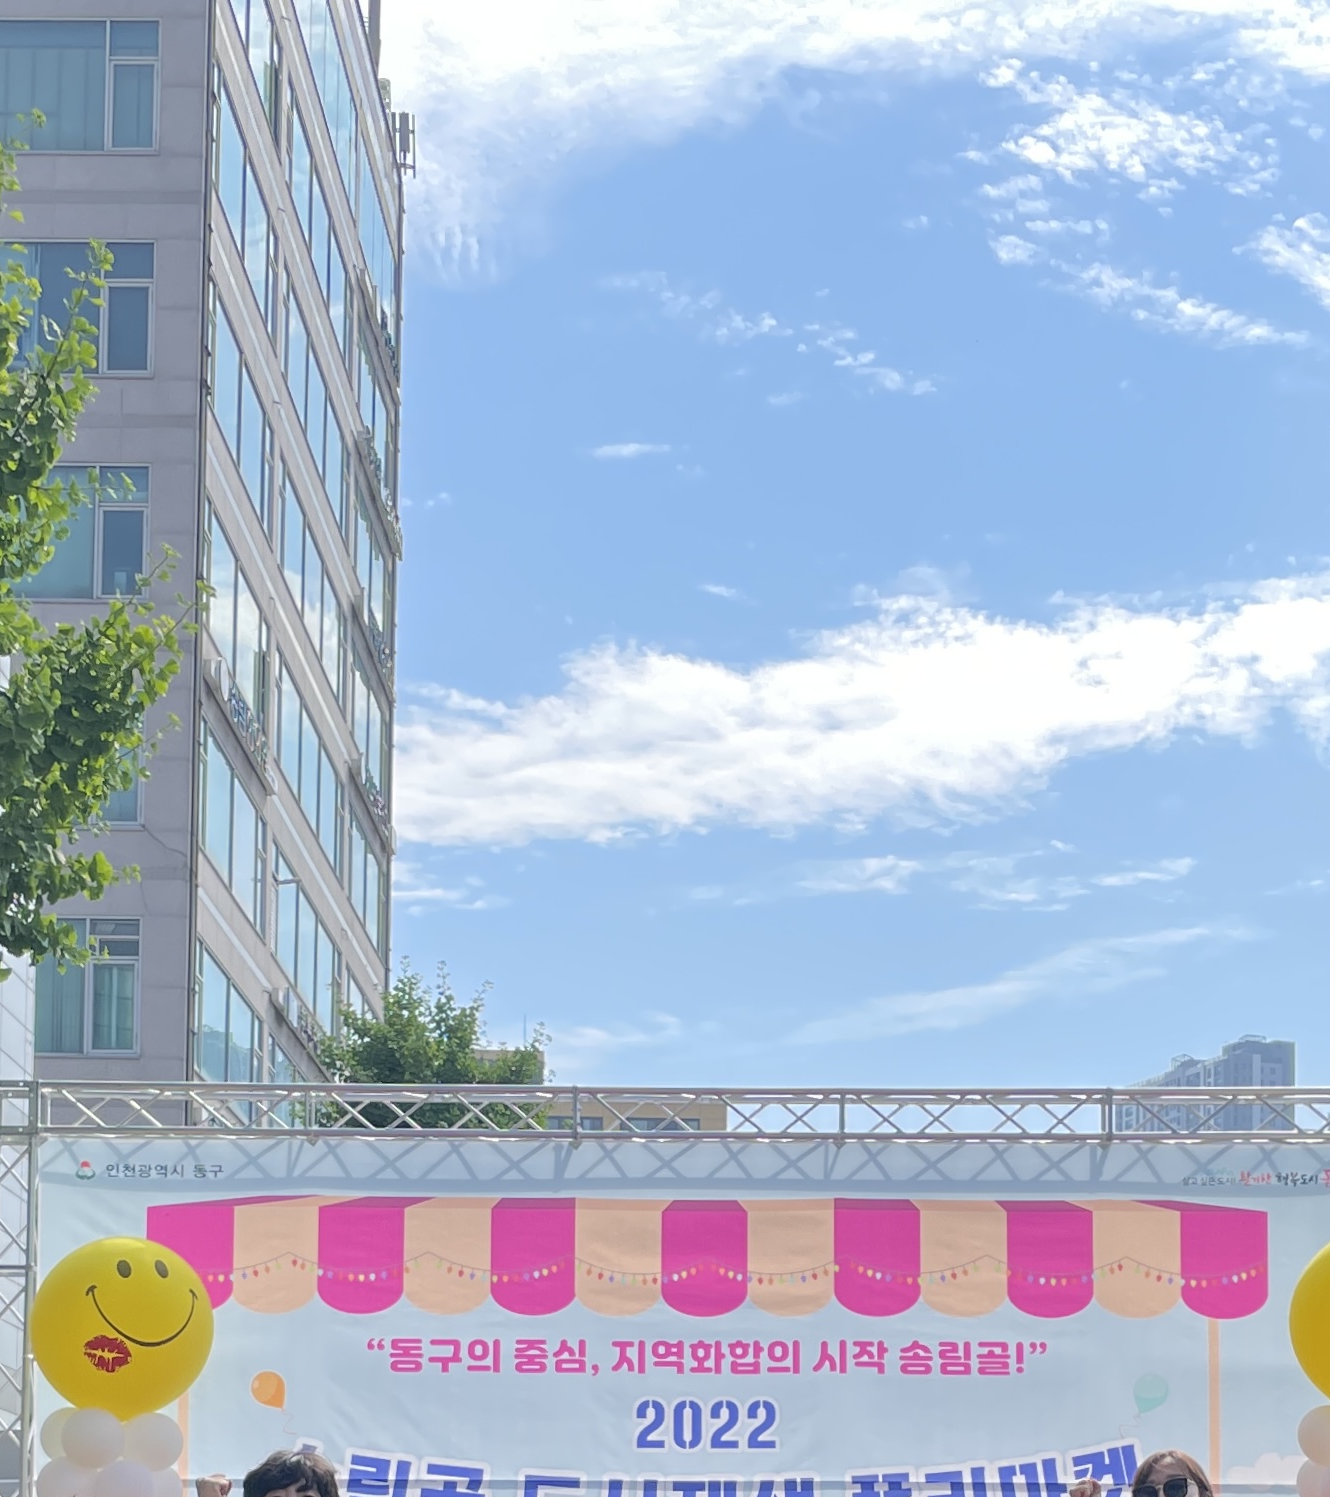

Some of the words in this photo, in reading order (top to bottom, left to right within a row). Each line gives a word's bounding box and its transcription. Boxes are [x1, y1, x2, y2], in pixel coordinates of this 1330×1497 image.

[106, 1164, 184, 1178] 인천광역시
[193, 1164, 224, 1178] 동구
[367, 1338, 501, 1375] “동구의
[514, 1338, 599, 1378] 중심,
[612, 1339, 801, 1376] 지역화합의
[812, 1339, 888, 1376] 시작
[899, 1340, 1048, 1376] 송림골!”
[635, 1399, 778, 1450] 2022
